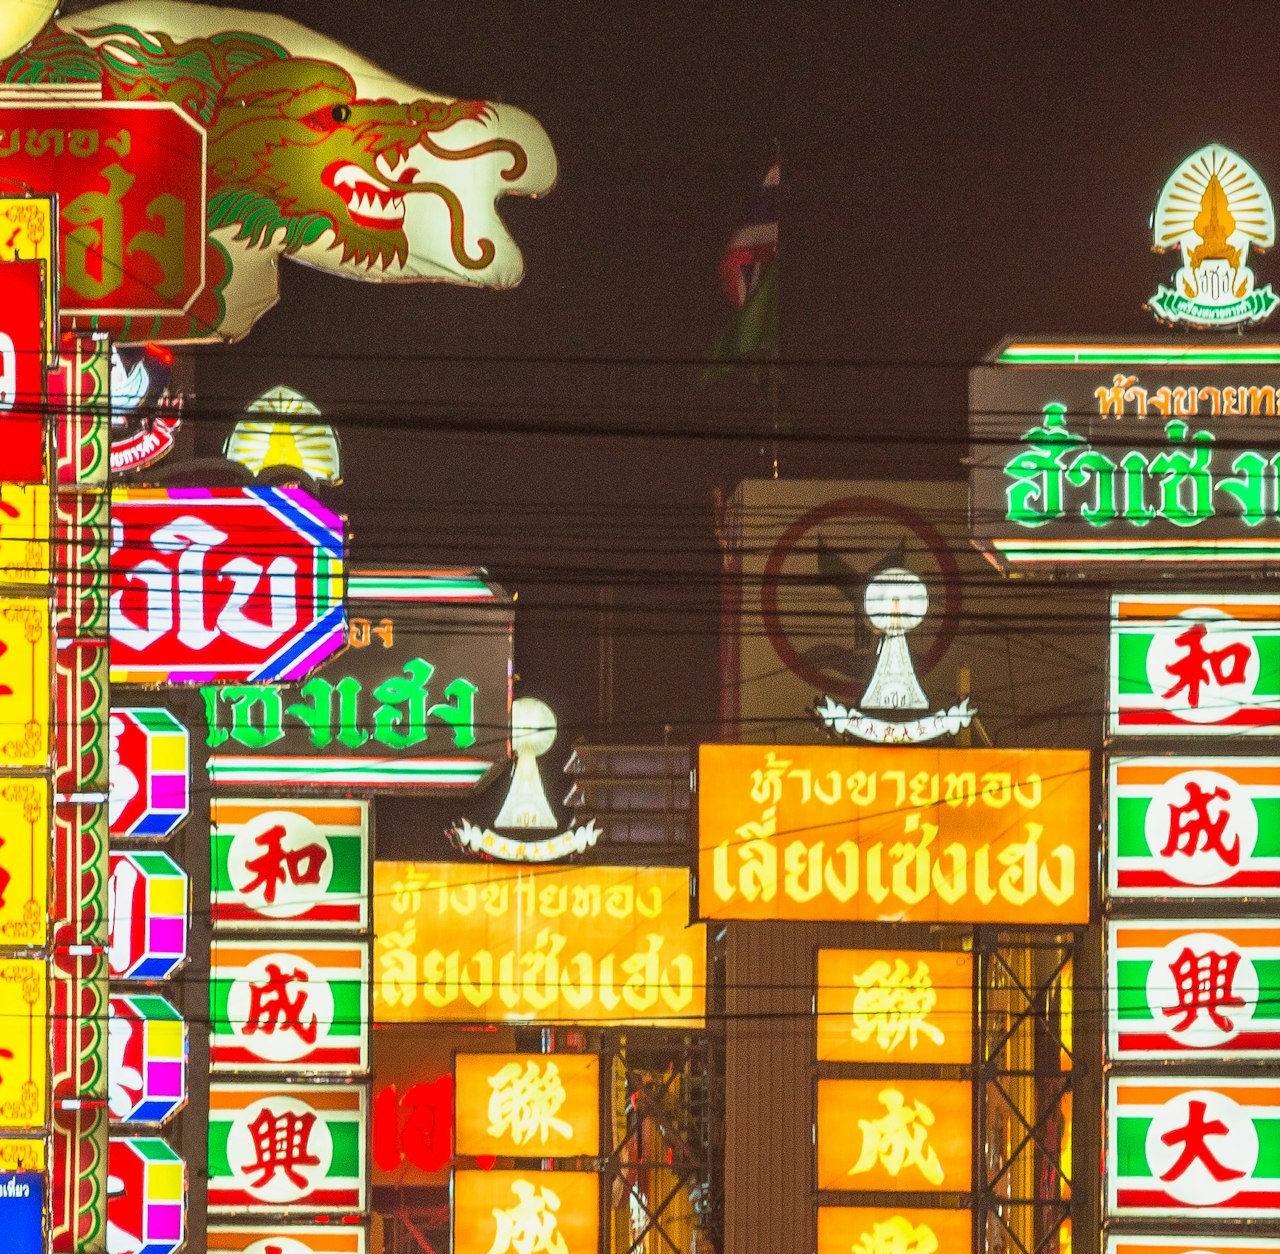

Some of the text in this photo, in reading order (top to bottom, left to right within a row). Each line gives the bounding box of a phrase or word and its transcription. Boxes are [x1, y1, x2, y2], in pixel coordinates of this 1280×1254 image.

[748, 753, 1042, 810] ห้างขายทอง
[713, 811, 1077, 906] เลี่ยงเซ่งเฮง
[390, 867, 663, 917] ห้างขายทอง
